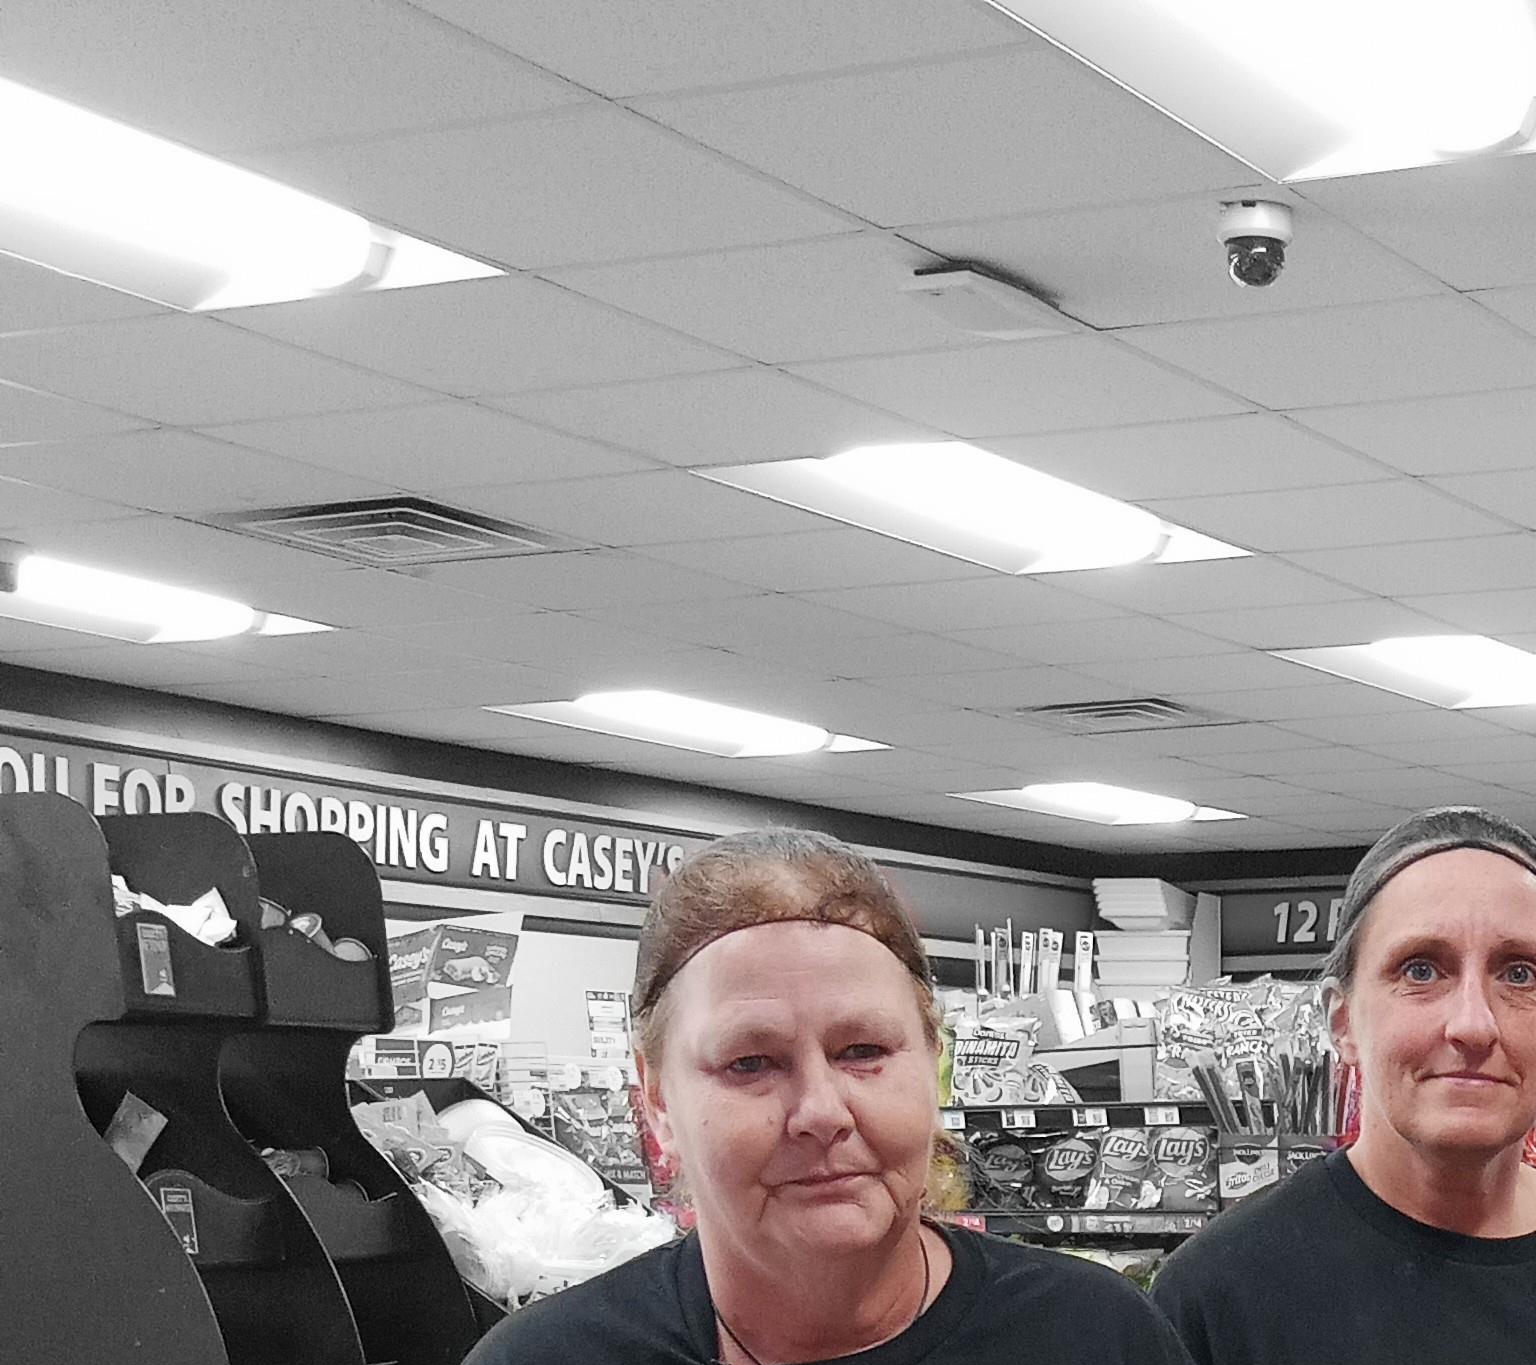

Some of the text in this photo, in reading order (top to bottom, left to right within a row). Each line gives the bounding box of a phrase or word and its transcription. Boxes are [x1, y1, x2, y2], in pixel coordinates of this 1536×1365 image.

[93, 762, 196, 815] FOR
[221, 782, 449, 873] SHOPPING
[471, 819, 527, 880] AT
